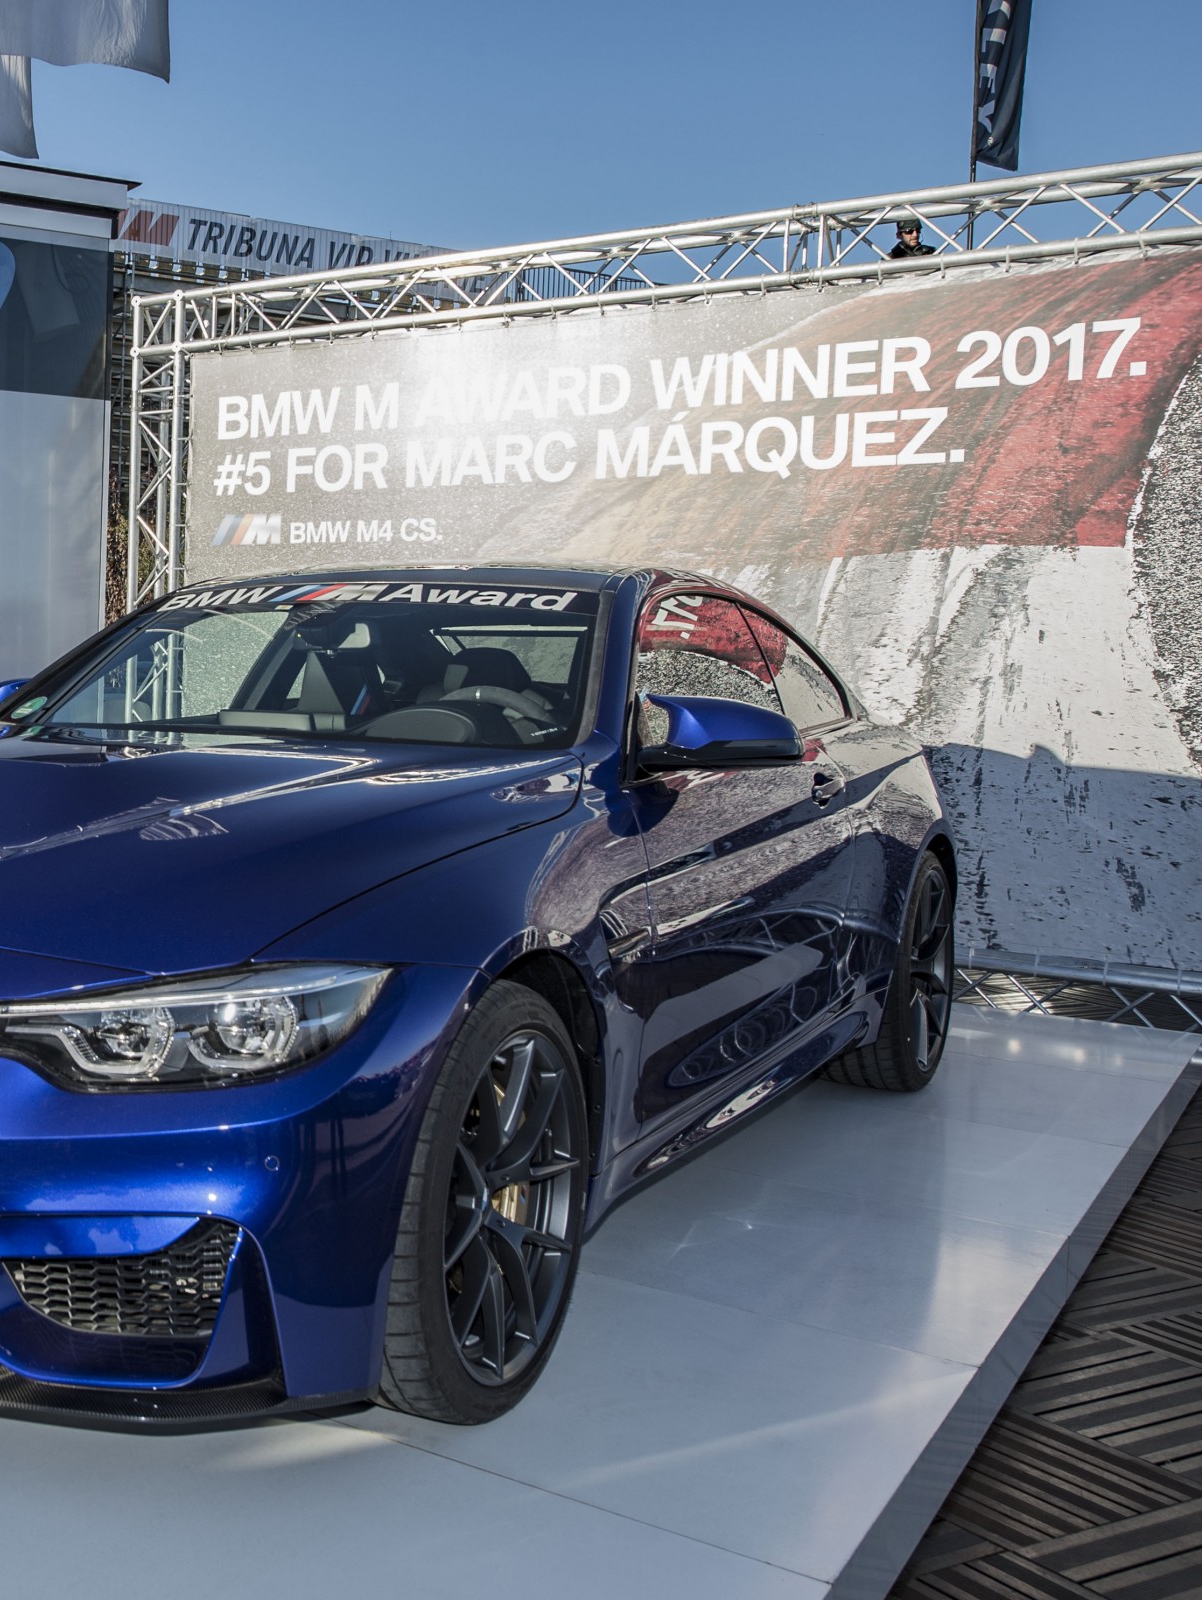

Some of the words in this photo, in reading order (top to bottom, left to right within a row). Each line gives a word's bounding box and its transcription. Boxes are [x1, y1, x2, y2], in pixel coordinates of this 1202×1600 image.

[188, 218, 315, 269] TRIBUNA
[328, 241, 374, 270] VIP
[217, 387, 341, 441] BMW
[354, 382, 399, 431] M
[415, 363, 631, 427] AWARD
[650, 336, 932, 411] WINNER
[955, 317, 1147, 389] 2017.
[213, 451, 271, 497] #5
[286, 442, 388, 494] FOR
[405, 430, 577, 489] MARC
[595, 407, 966, 480] MÁRQUEZ.
[290, 520, 351, 544] BMW
[357, 519, 393, 543] M4
[400, 517, 443, 542] CS.
[159, 586, 283, 611] BMW
[320, 584, 388, 601] M
[383, 584, 577, 611] Award
